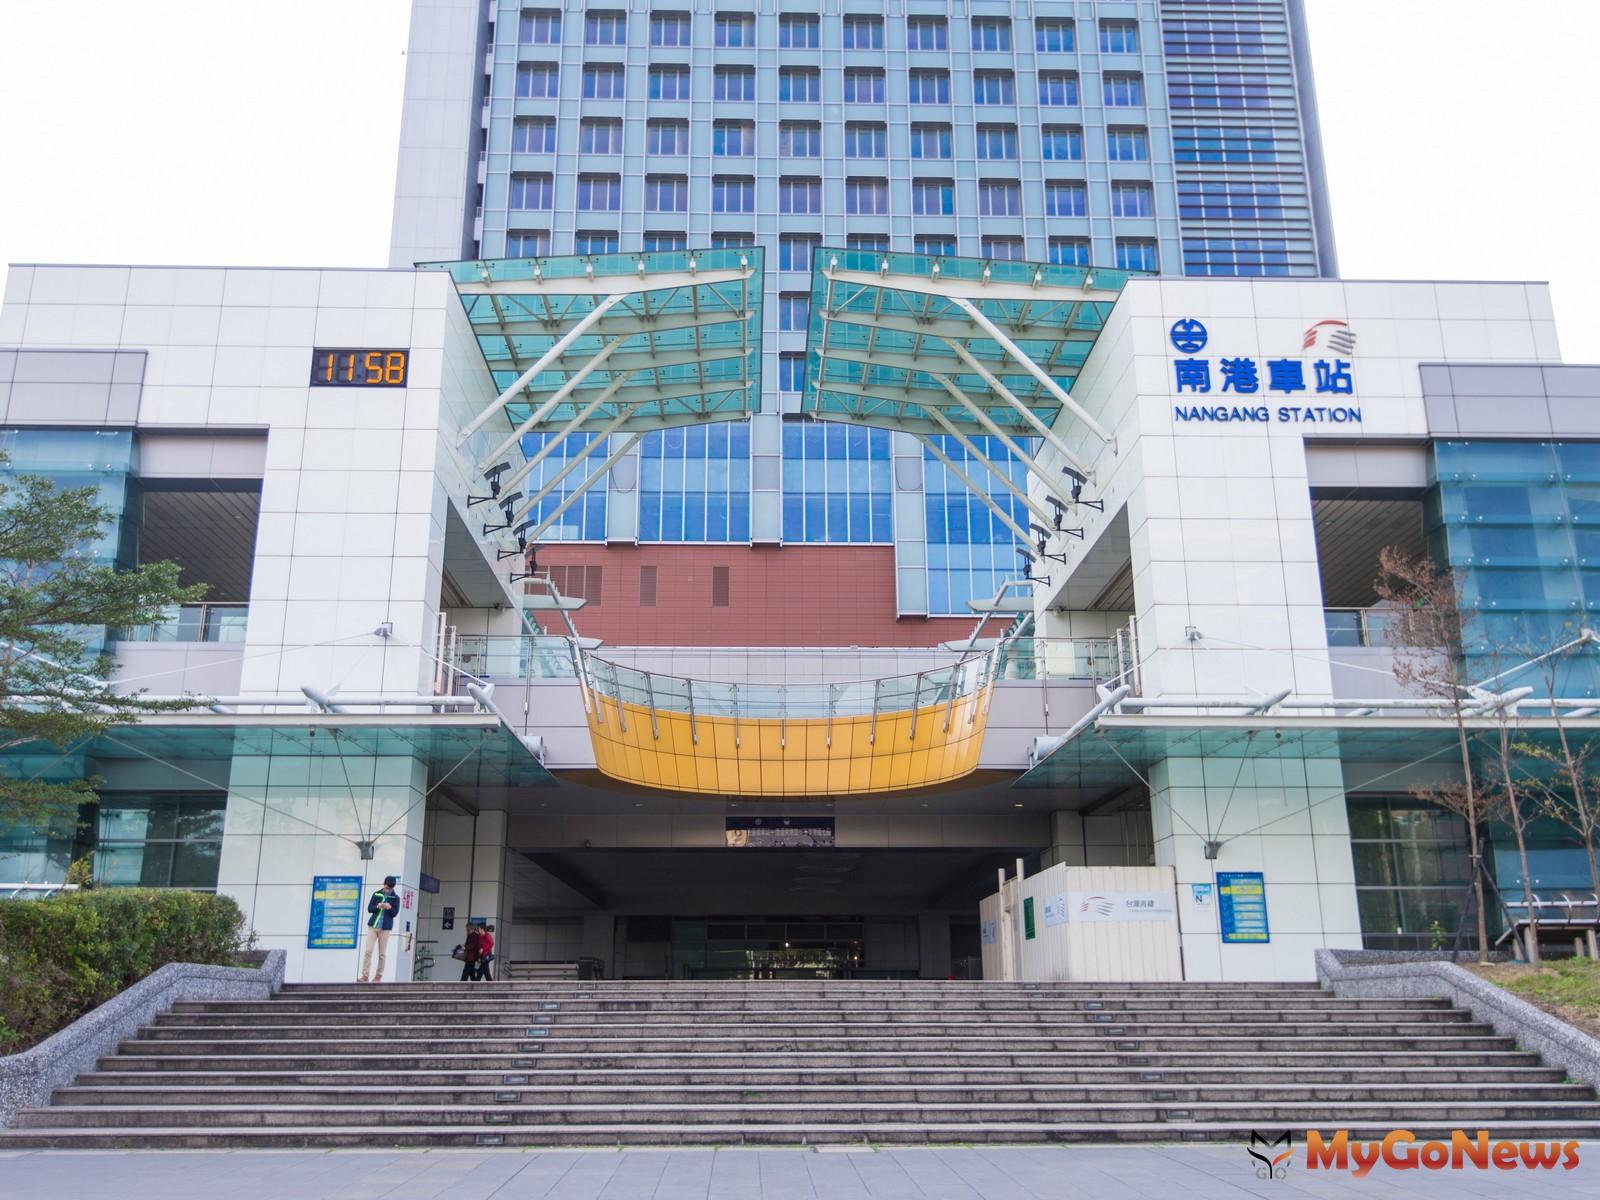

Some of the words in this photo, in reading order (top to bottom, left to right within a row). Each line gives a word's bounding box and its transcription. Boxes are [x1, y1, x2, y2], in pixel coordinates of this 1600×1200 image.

[1173, 357, 1354, 395] 南港車站
[1174, 405, 1271, 422] NANGANG
[1277, 406, 1363, 423] STATION
